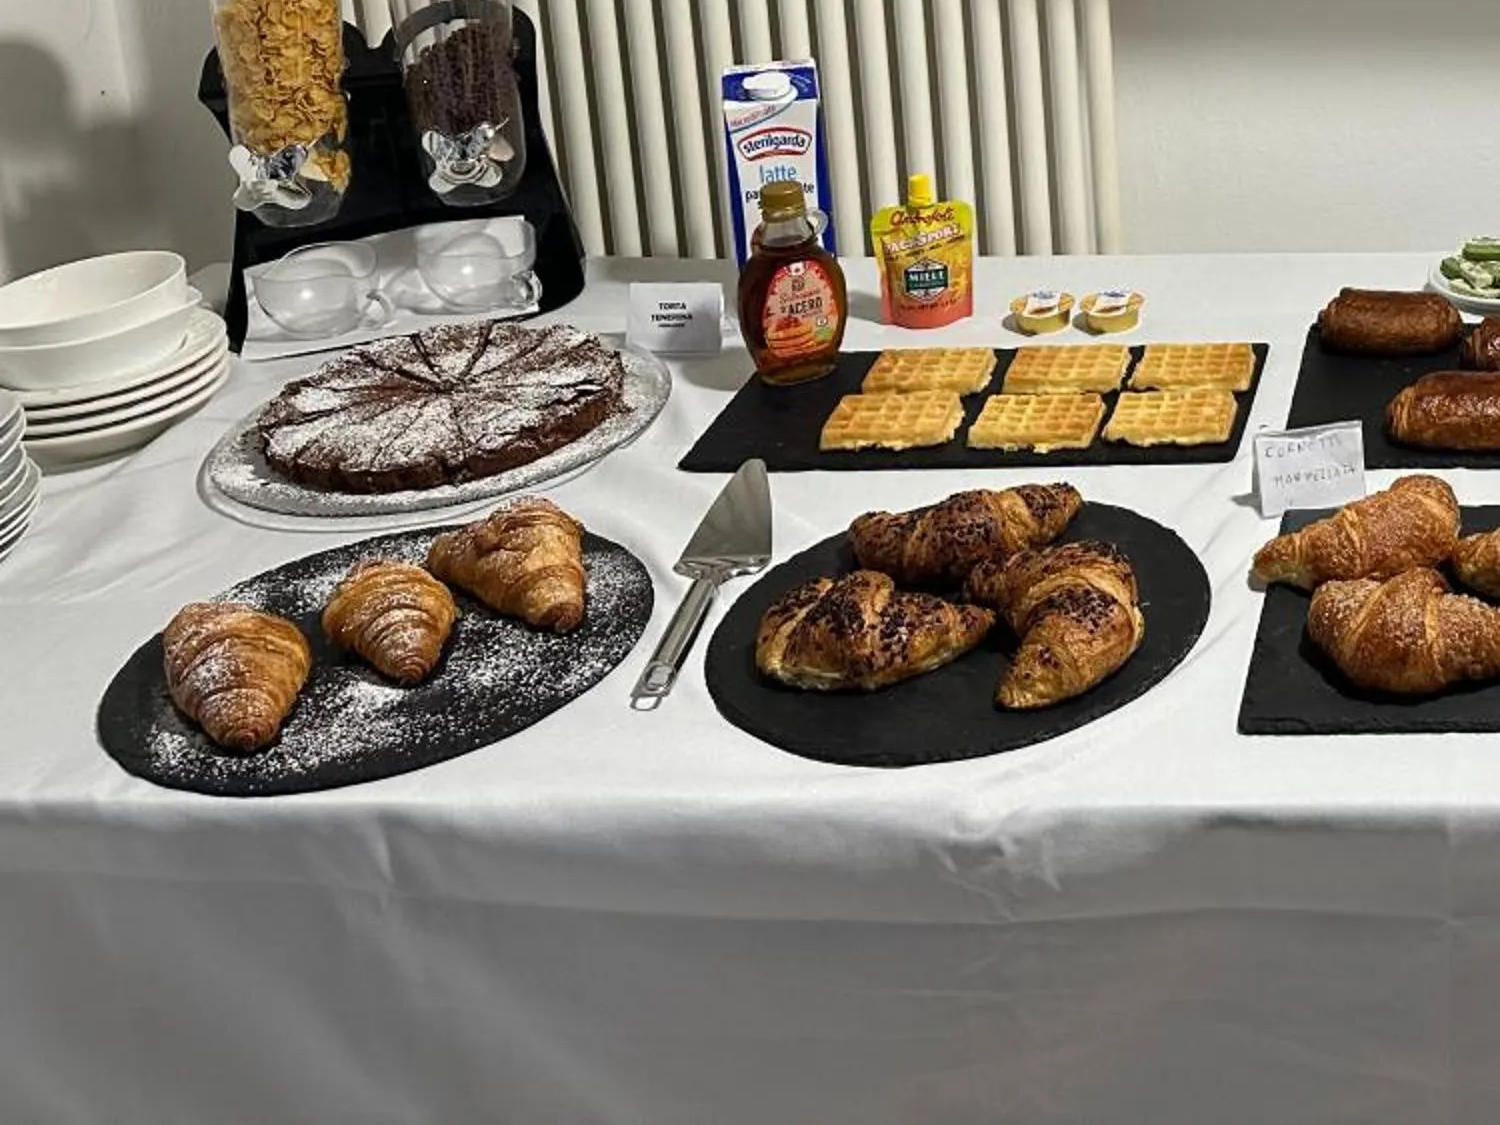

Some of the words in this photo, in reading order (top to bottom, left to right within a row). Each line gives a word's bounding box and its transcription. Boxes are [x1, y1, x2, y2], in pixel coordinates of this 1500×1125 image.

[743, 133, 806, 154] sterilgarda
[759, 164, 798, 183] latte
[658, 302, 687, 311] TORTA
